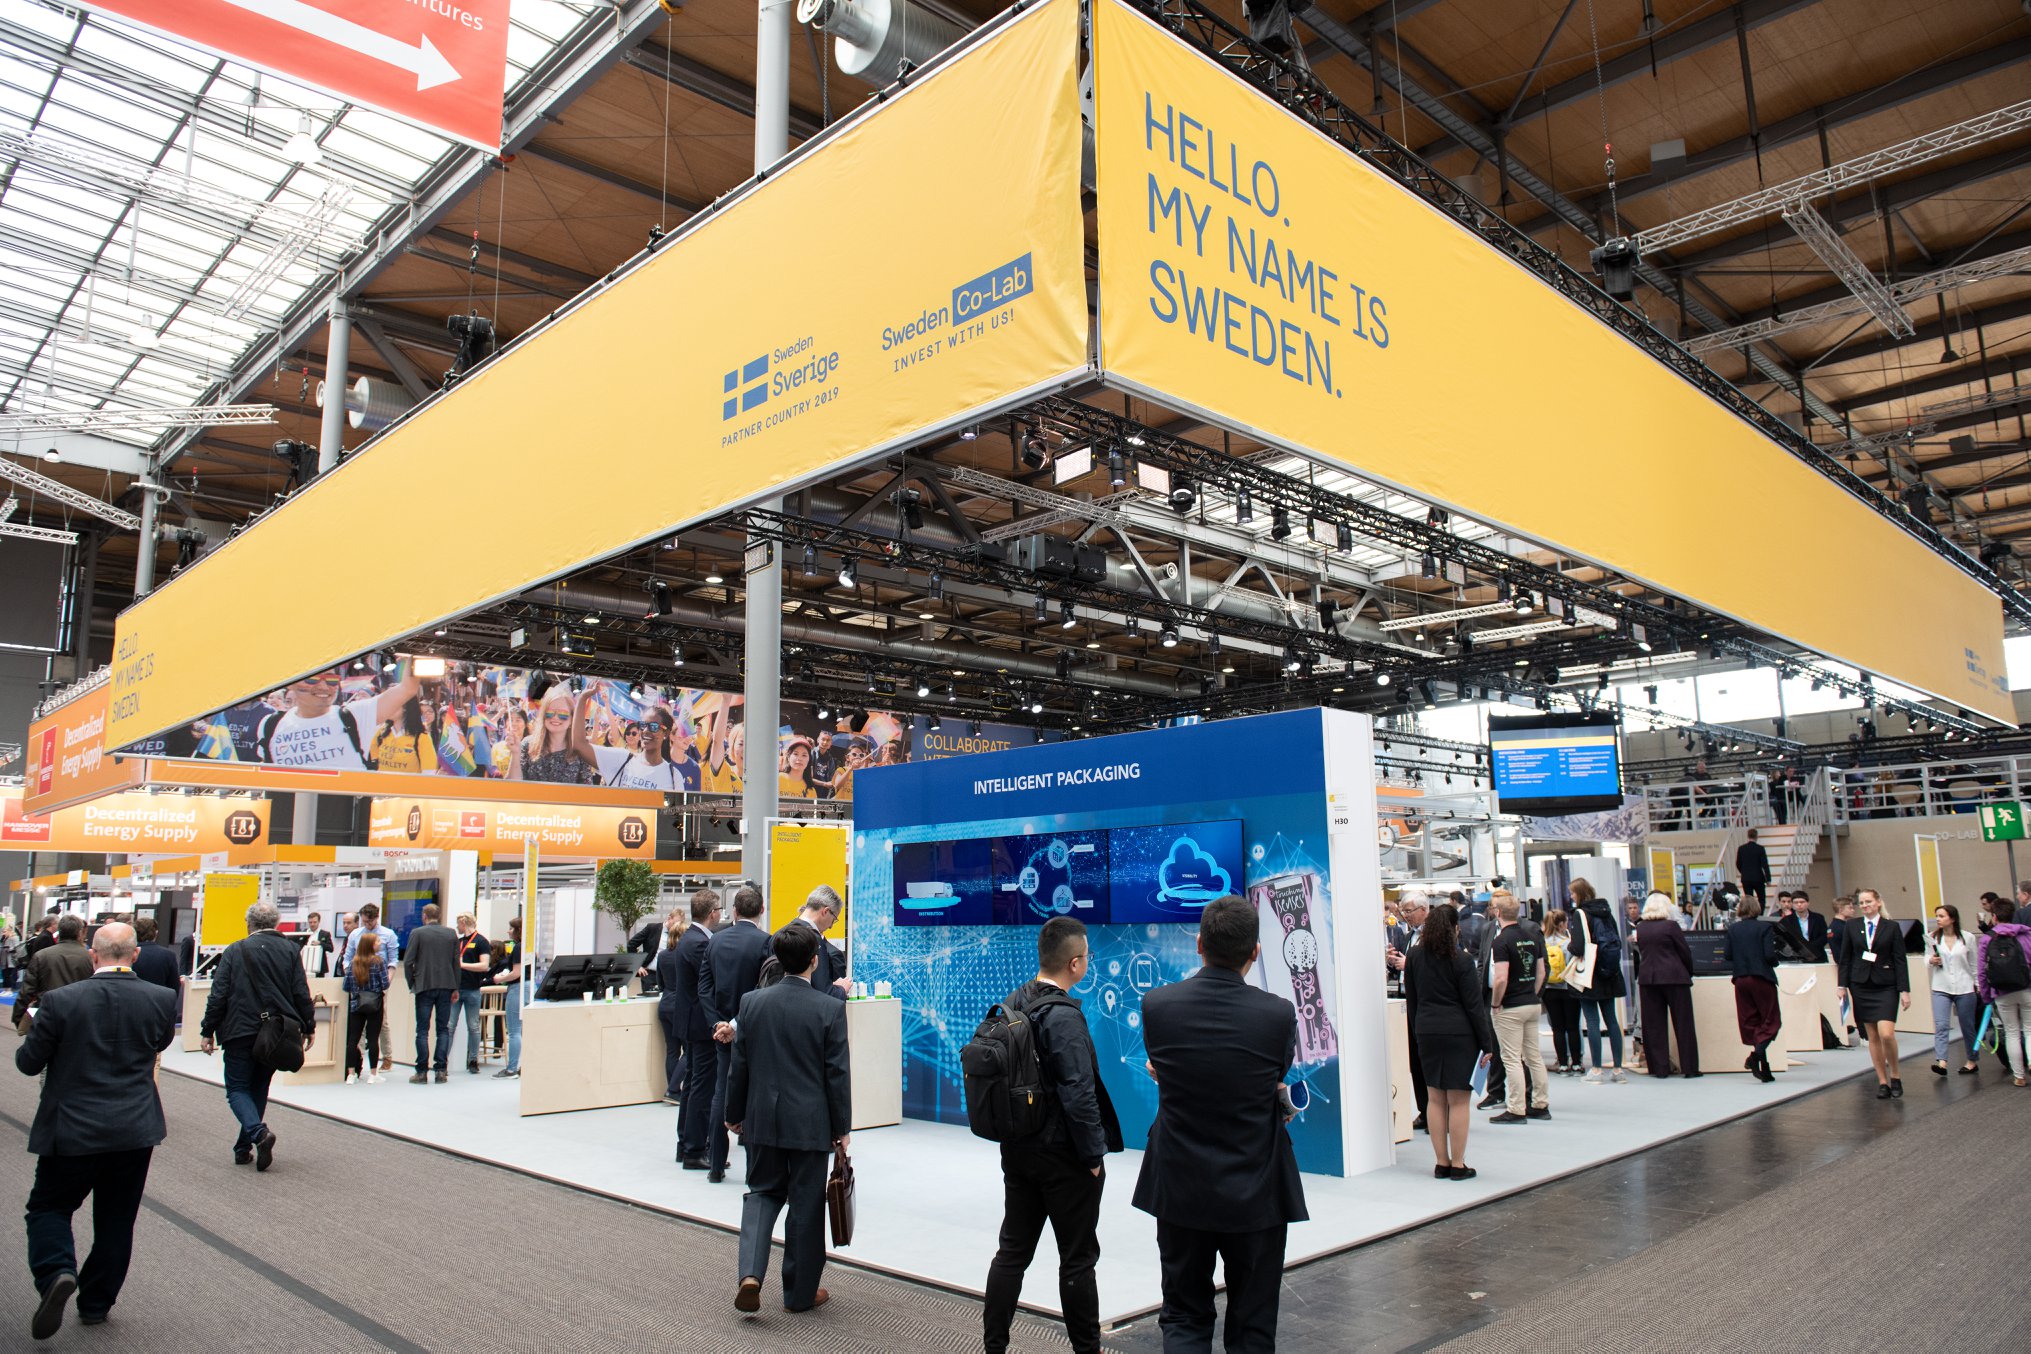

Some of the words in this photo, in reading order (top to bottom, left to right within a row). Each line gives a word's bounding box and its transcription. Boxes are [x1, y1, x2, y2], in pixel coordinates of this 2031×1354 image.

[1146, 91, 1290, 227] HELLO.
[1148, 172, 1211, 257] MY
[1228, 215, 1340, 326] NAME
[1350, 283, 1389, 349] IS
[882, 306, 949, 351] Sweden
[957, 267, 1027, 317] Co-Lab
[894, 340, 941, 372] INVEST
[947, 322, 984, 348] WITH
[991, 308, 1014, 329] US!
[1150, 259, 1342, 398] SWEDEN.
[773, 335, 813, 364] Sweden
[773, 351, 839, 397] Sverige
[722, 413, 762, 448] PARTNER
[765, 394, 811, 428] COUNTRY
[814, 387, 839, 408] 2019
[275, 727, 331, 743] SWEDEN
[974, 773, 1053, 794] INTELLIGENT
[1057, 763, 1140, 786] PACKAGING
[85, 806, 196, 824] Decentralized
[497, 812, 581, 829] Decentralized
[83, 823, 140, 840] Energy
[144, 825, 198, 842] Supply
[542, 831, 583, 846] Supply
[384, 850, 408, 858] BOSCH
